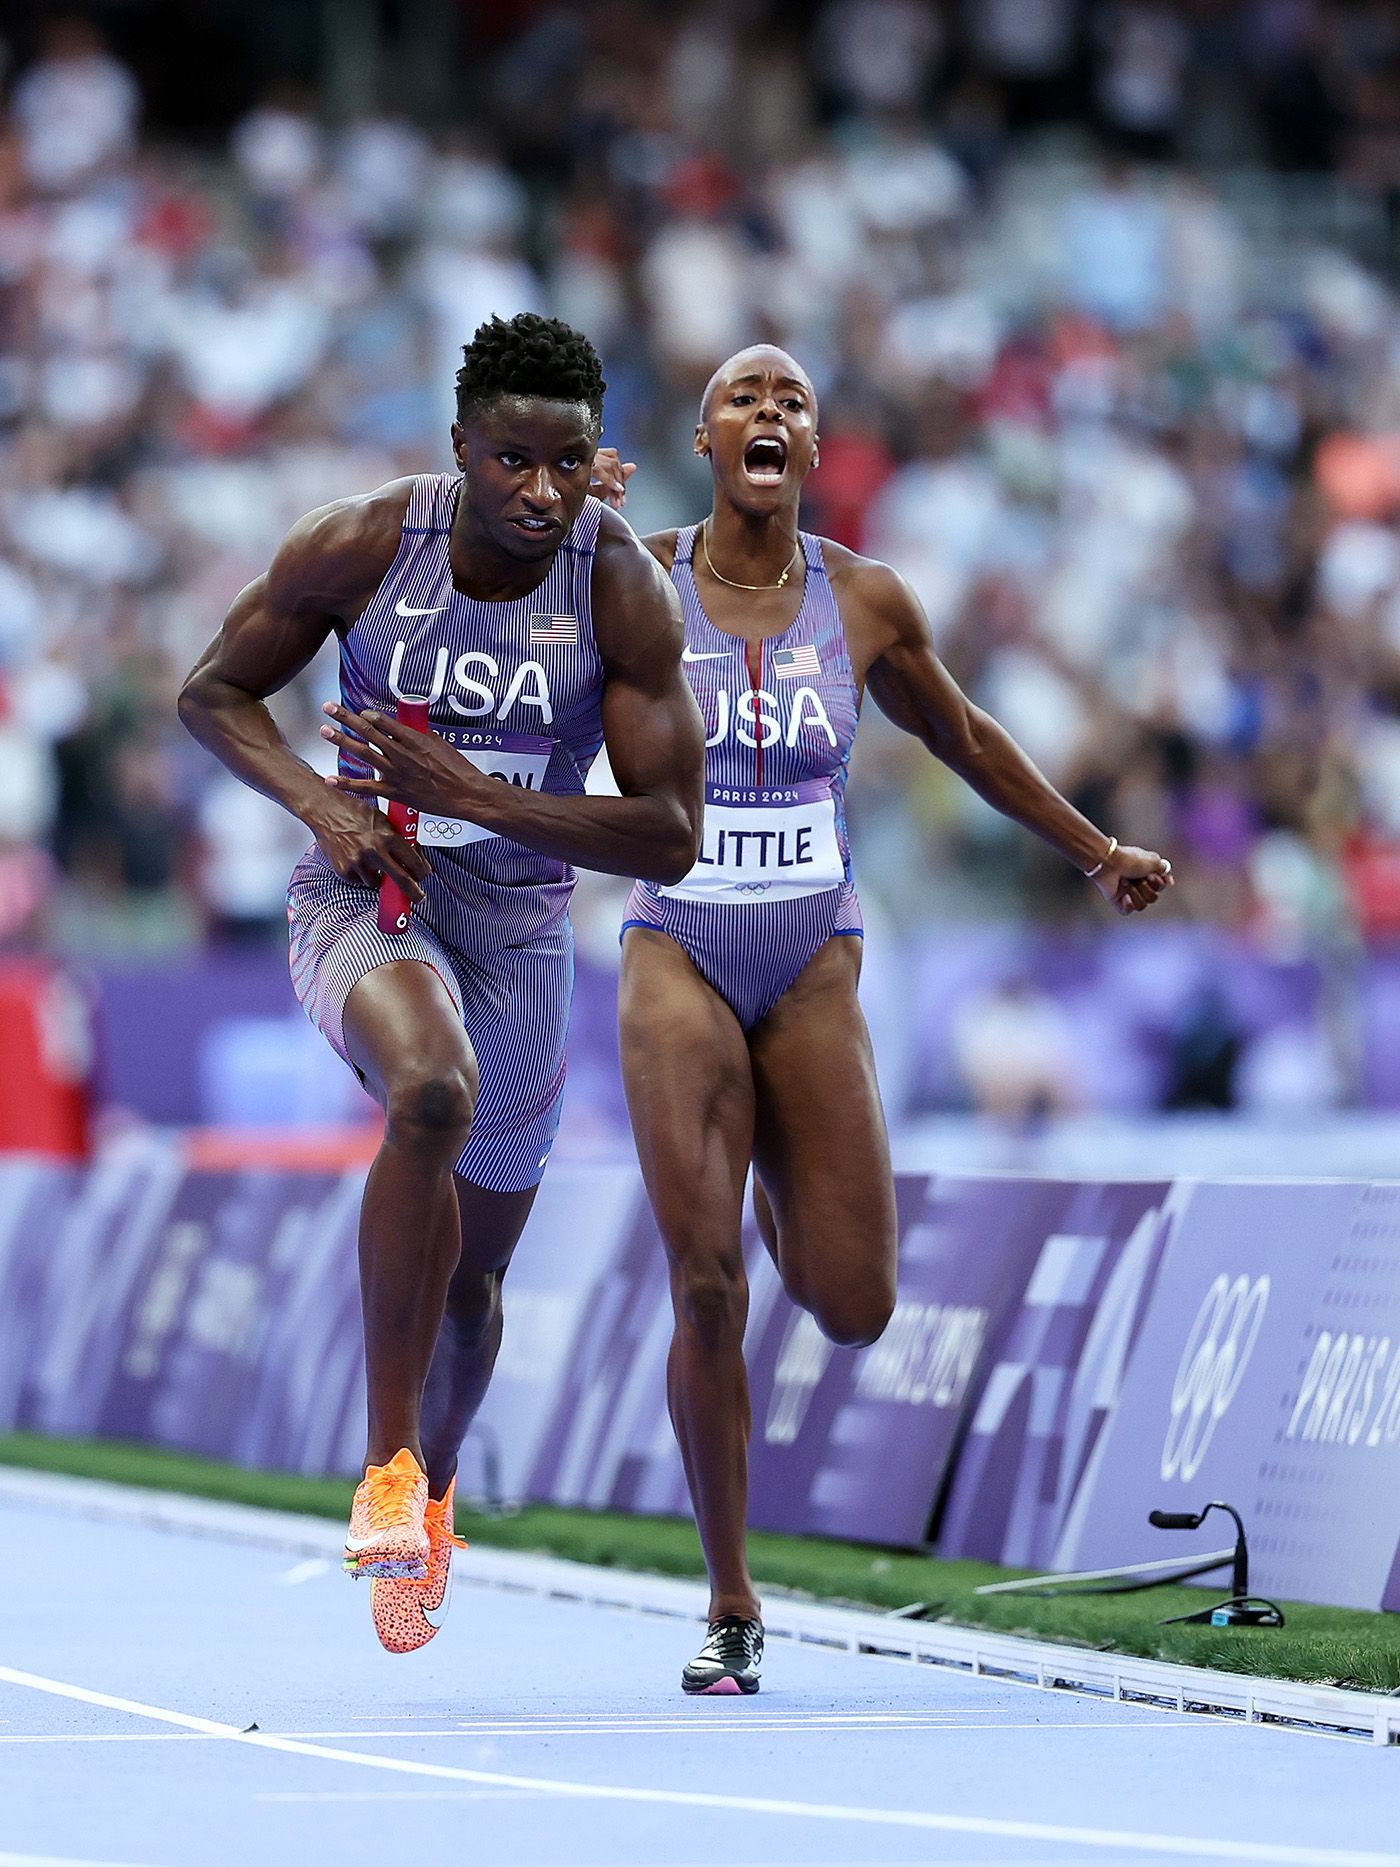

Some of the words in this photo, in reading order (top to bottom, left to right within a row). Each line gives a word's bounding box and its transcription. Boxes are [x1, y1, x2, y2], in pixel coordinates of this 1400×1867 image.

[388, 640, 553, 725] USA
[462, 733, 503, 746] 2024
[713, 788, 756, 802] PARIS
[762, 790, 799, 802] 2024
[697, 826, 813, 867] LITTLE
[396, 912, 408, 929] 6
[1286, 1330, 1391, 1446] PARIS
